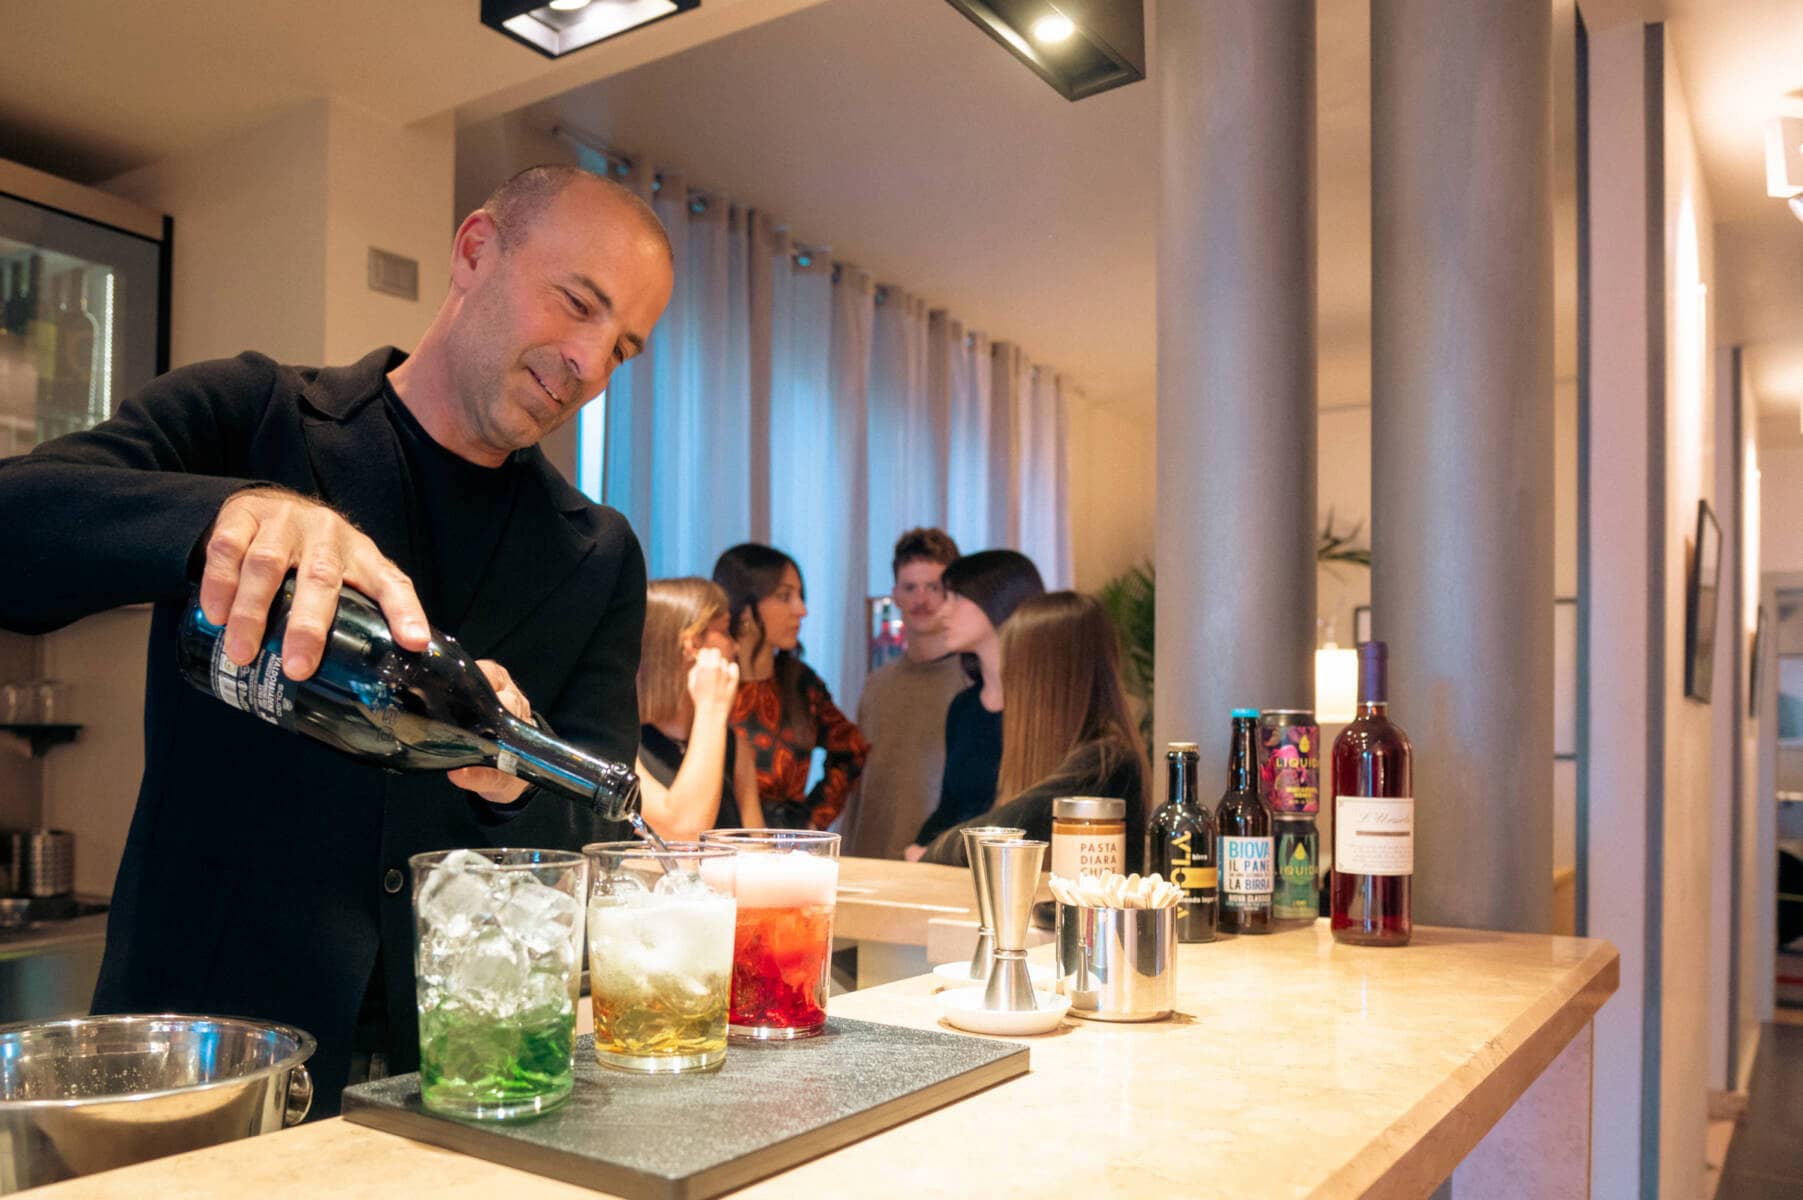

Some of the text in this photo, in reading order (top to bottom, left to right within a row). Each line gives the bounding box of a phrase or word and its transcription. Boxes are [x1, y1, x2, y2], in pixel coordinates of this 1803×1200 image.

[1081, 843, 1117, 853] PASTA
[1081, 855, 1117, 865] DIARA
[1229, 860, 1238, 872] IL
[1081, 867, 1117, 878] CHI
[1229, 879, 1241, 891] LA
